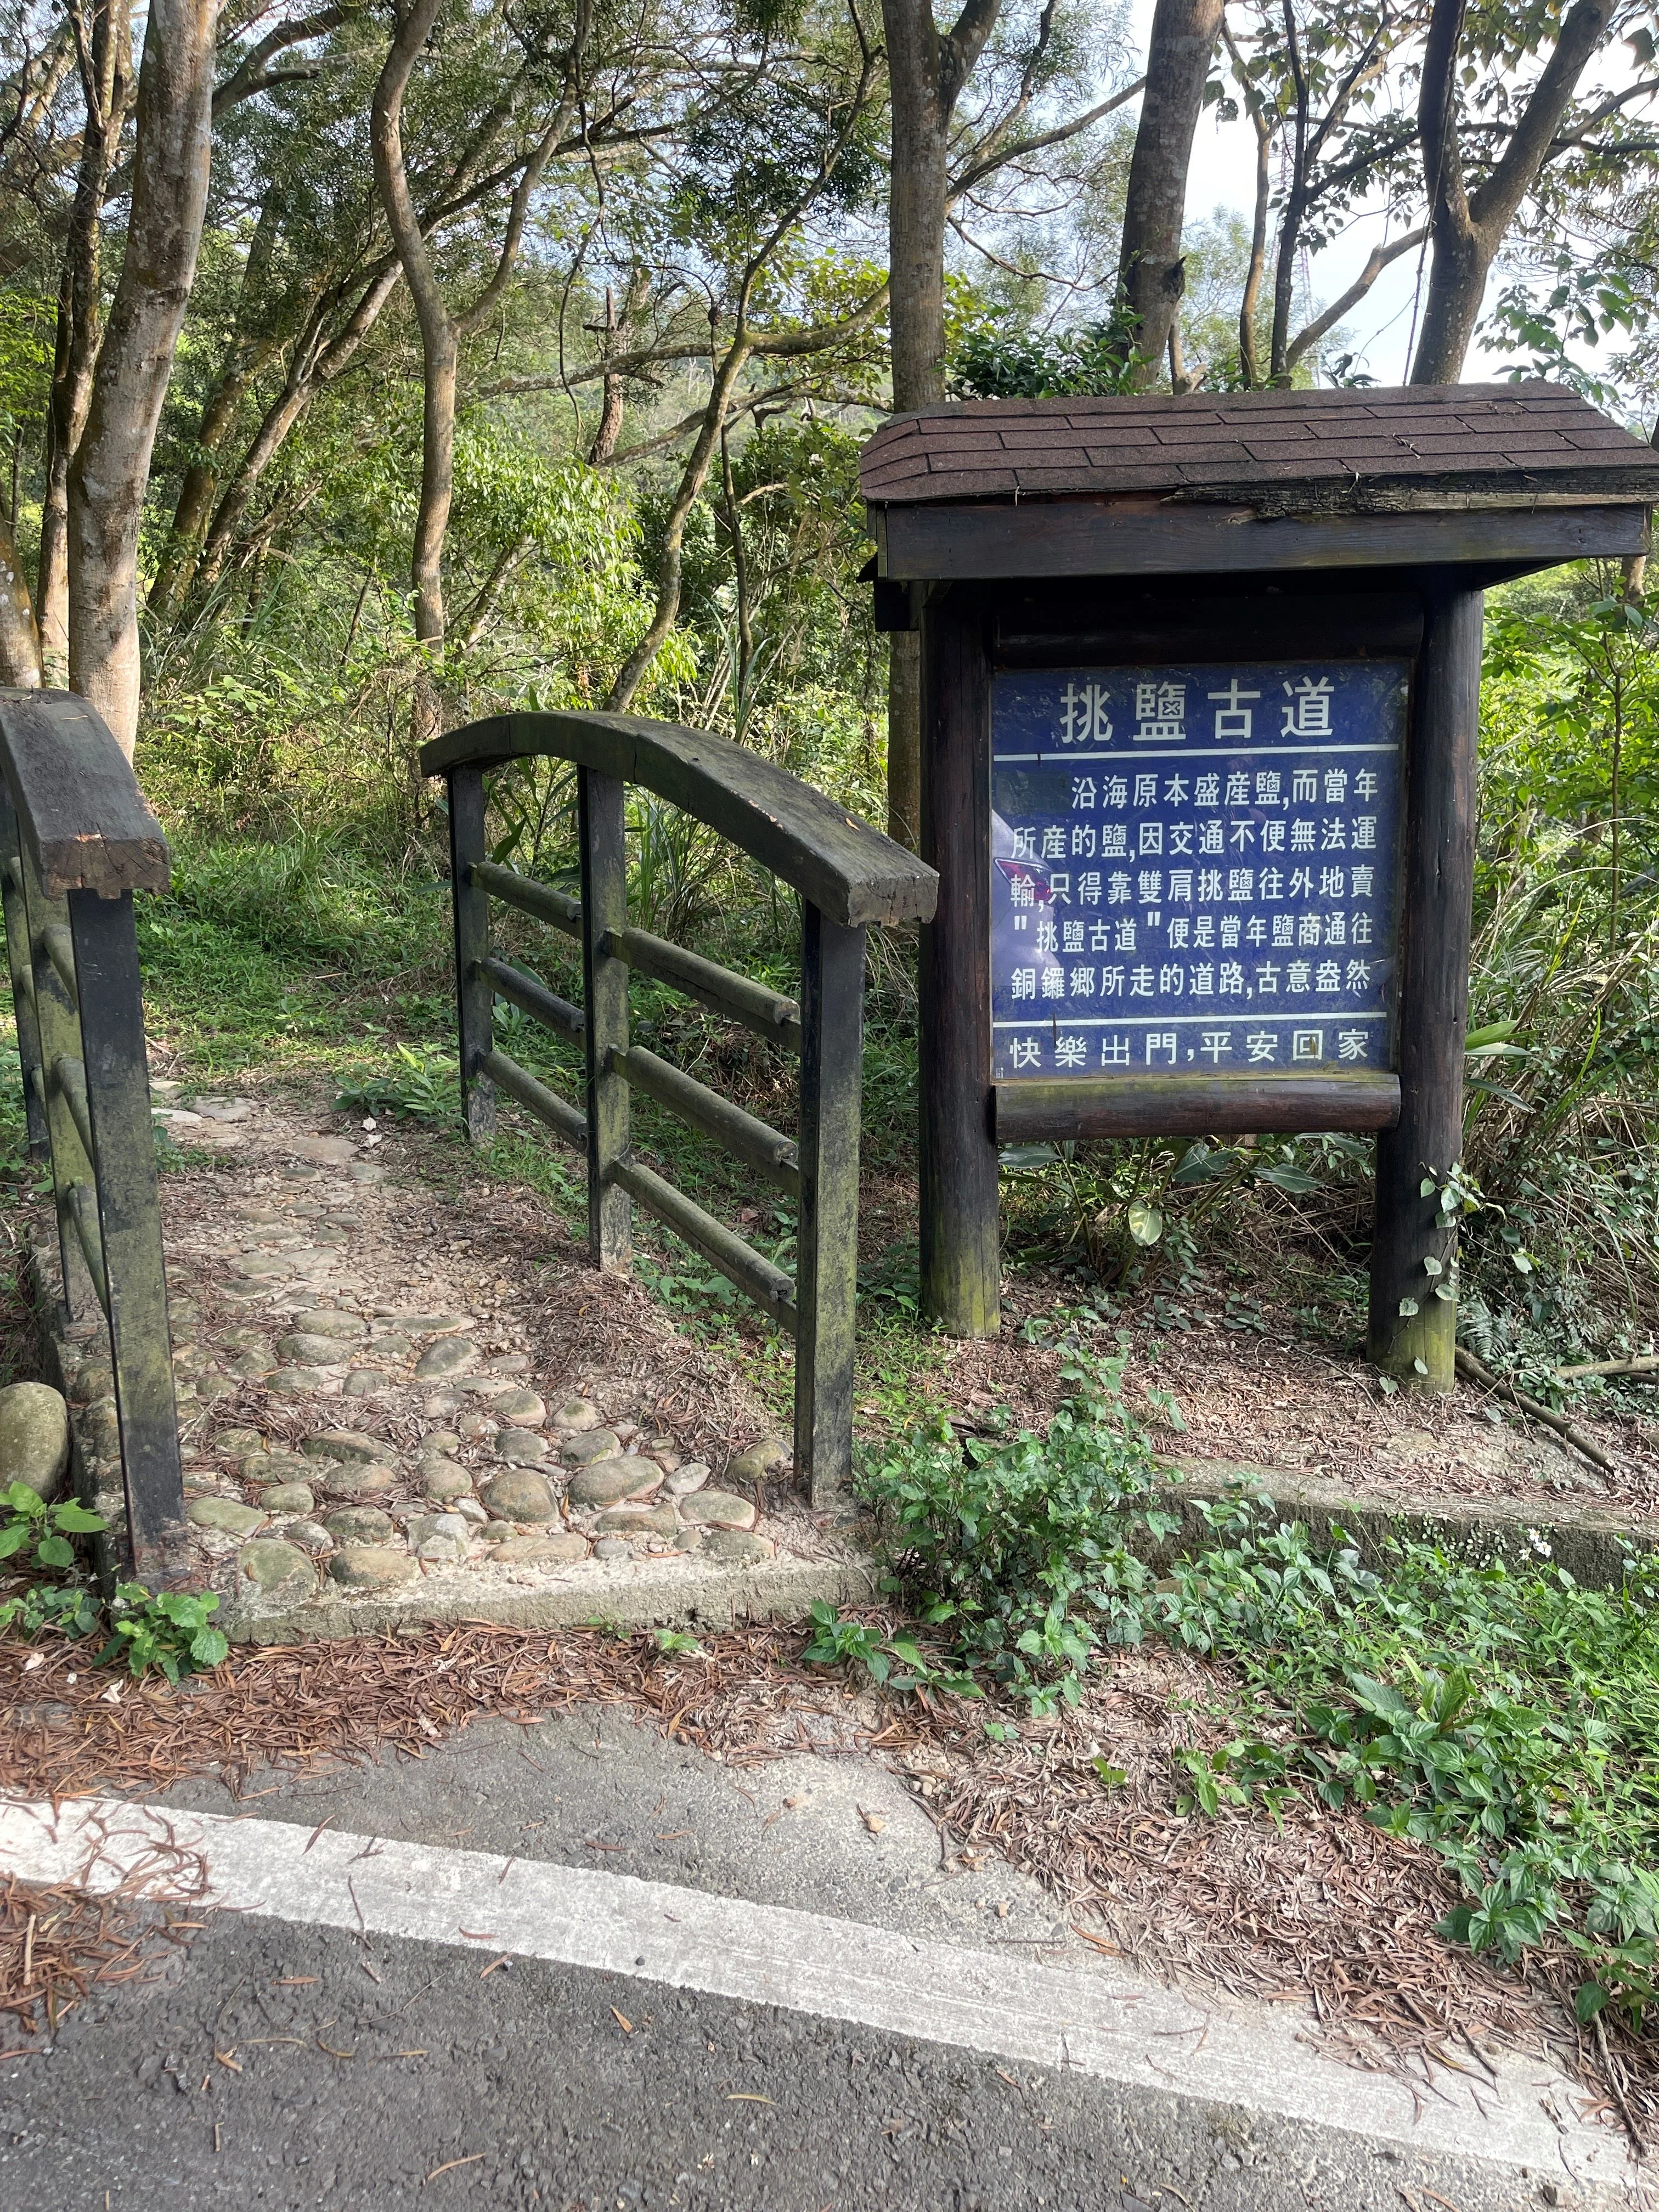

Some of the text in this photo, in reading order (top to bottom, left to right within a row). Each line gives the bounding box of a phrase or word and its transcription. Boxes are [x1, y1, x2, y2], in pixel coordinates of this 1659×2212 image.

[1060, 676, 1335, 744] 挑鹽古道
[1009, 1028, 1368, 1069] 快樂出門,平安回家
